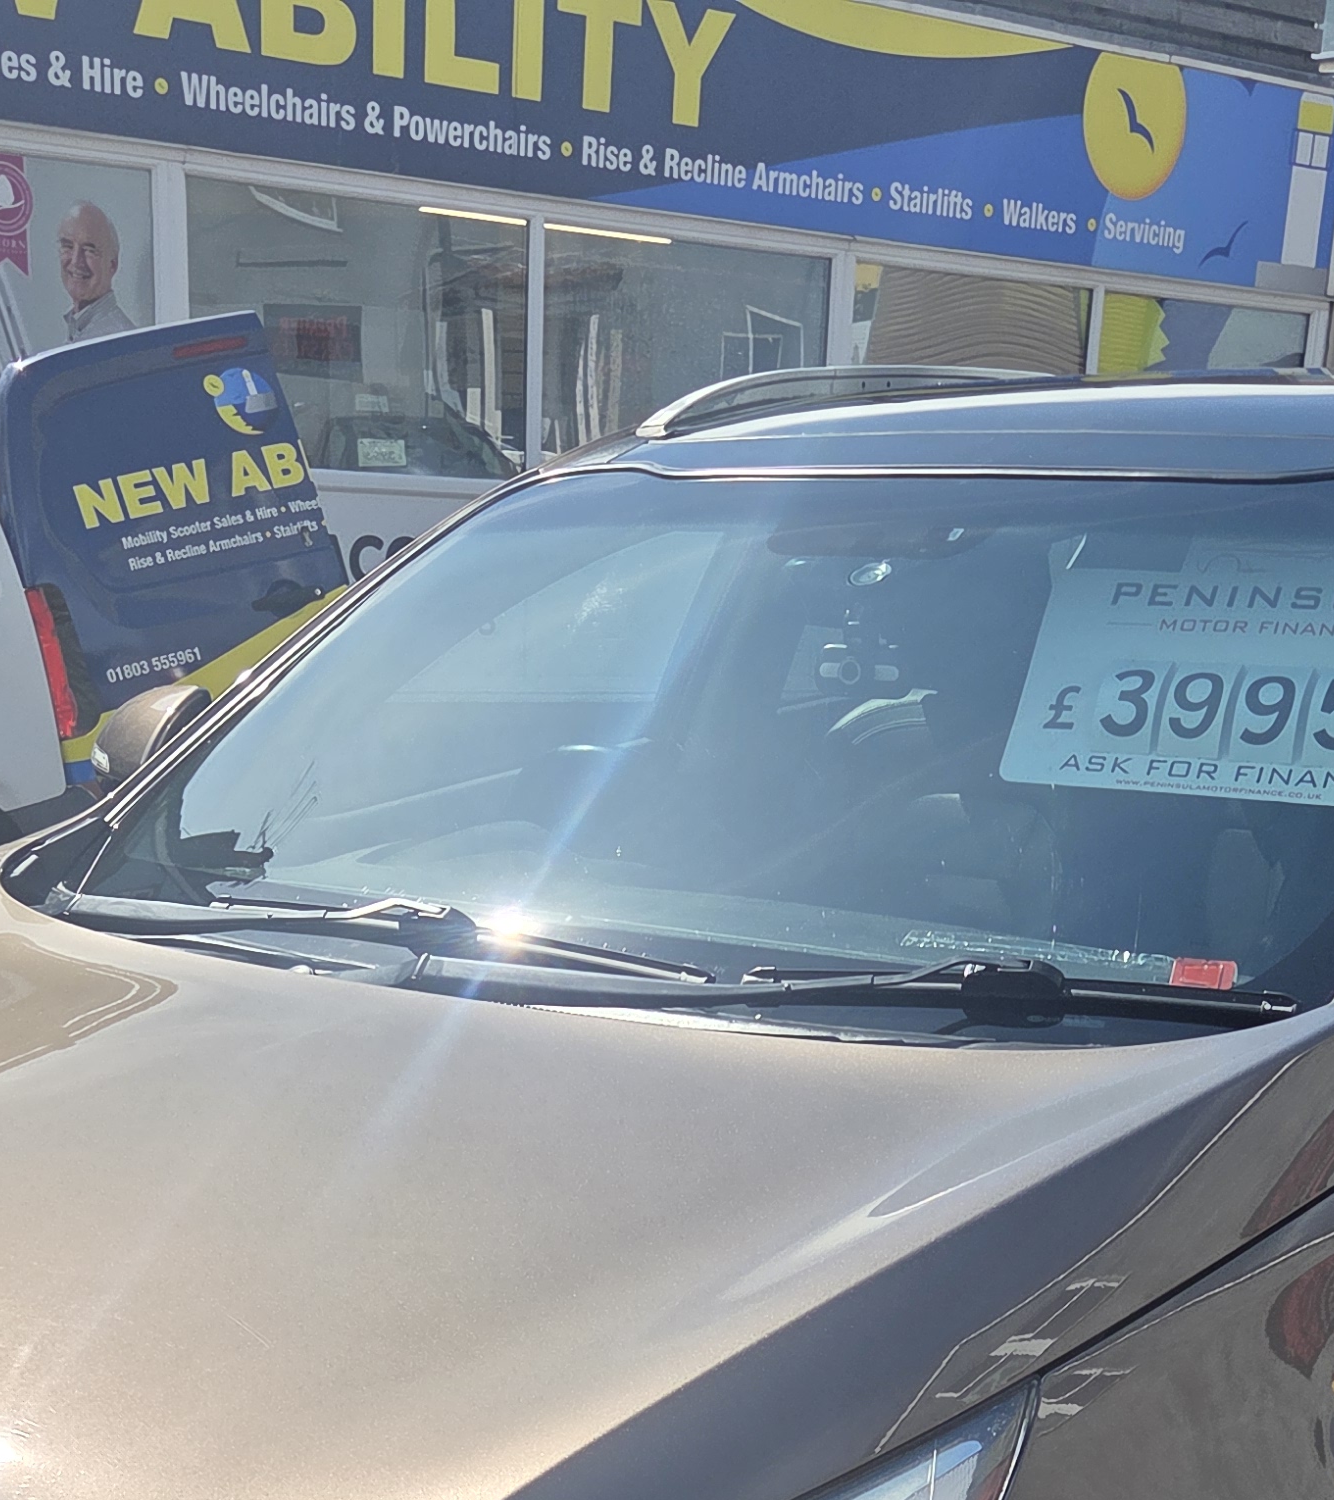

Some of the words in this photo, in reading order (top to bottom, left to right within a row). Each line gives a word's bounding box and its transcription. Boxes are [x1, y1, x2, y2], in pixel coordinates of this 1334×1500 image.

[48, 51, 71, 88] &
[82, 56, 144, 98] Hire
[181, 71, 355, 131] Wheelchairs
[364, 101, 385, 135] &
[393, 106, 552, 160] Powerchairs
[582, 135, 632, 172] Rise
[639, 145, 656, 176] &
[664, 148, 746, 188] Recline
[753, 161, 864, 206] Armchairs
[889, 181, 973, 220] Stairlifts
[1003, 199, 1077, 235] Walkers
[1104, 213, 1185, 254] Servicing
[72, 458, 210, 529] NEW
[121, 529, 167, 550] Mobility
[169, 519, 211, 539] Scooter
[214, 512, 244, 530] Sales
[245, 510, 255, 522] &
[255, 505, 279, 520] Hire
[128, 554, 153, 571] Rise
[155, 552, 165, 565] &
[166, 543, 207, 562] Recline
[209, 531, 264, 553] Armchairs
[1159, 617, 1248, 635] MOTOR
[106, 656, 150, 684] 01803
[153, 645, 203, 674] 555961
[1059, 754, 1134, 774] ASK
[1146, 759, 1219, 781] FOR
